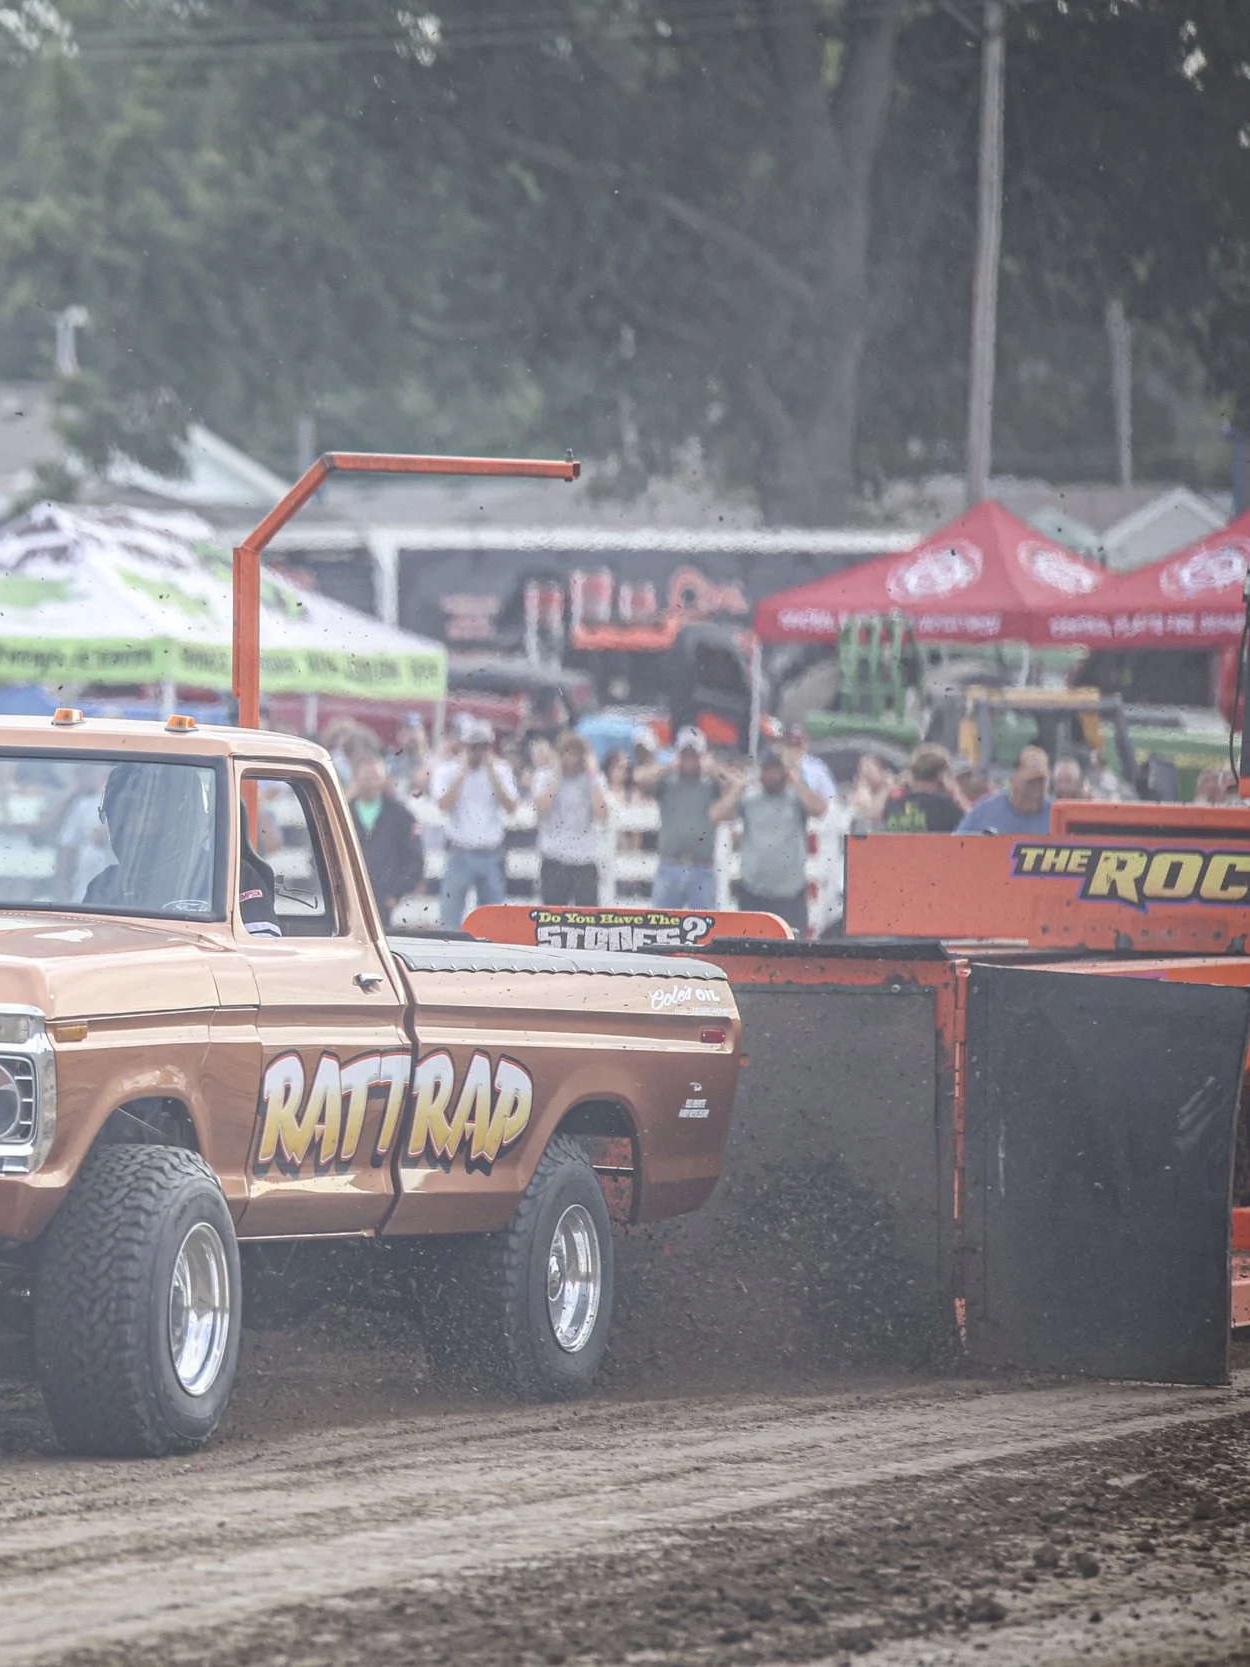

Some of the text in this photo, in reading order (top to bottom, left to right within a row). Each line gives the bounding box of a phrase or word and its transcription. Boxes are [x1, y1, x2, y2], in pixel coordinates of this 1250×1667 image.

[1021, 847, 1092, 872] THE
[565, 913, 596, 924] You
[600, 914, 644, 925] Have
[648, 914, 680, 925] The
[695, 988, 720, 1001] OIL
